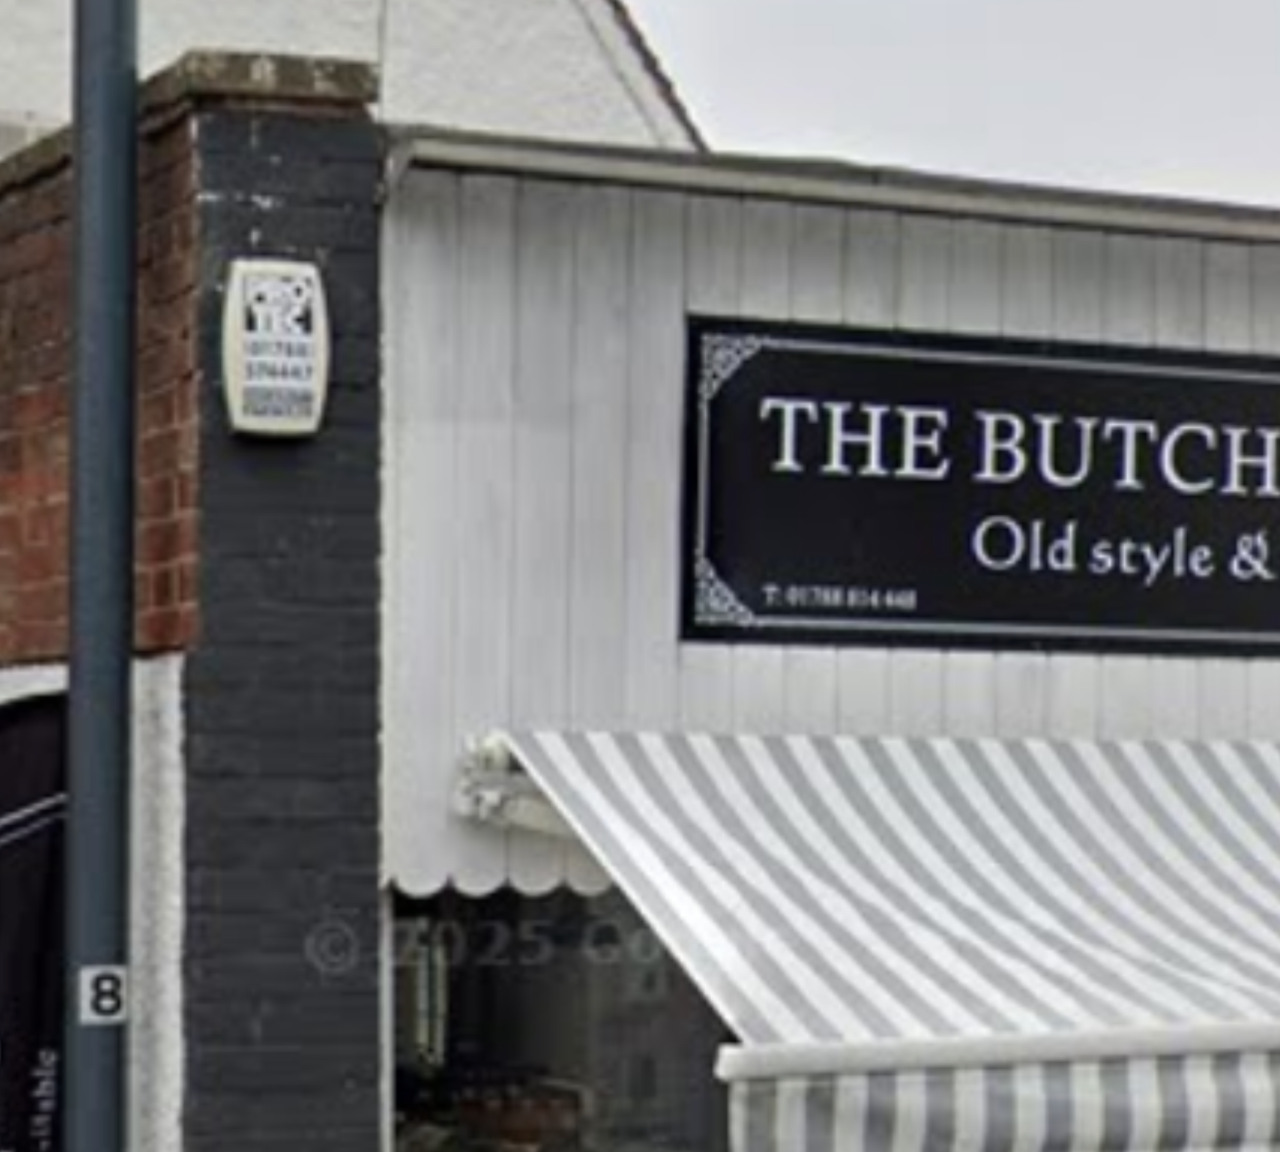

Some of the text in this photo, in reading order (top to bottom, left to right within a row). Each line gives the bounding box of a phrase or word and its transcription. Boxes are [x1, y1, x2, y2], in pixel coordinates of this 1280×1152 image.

[759, 396, 951, 480] THE
[972, 515, 1078, 571] Old
[1089, 526, 1216, 586] style
[1229, 529, 1276, 581] &
[89, 973, 122, 1017] 8
